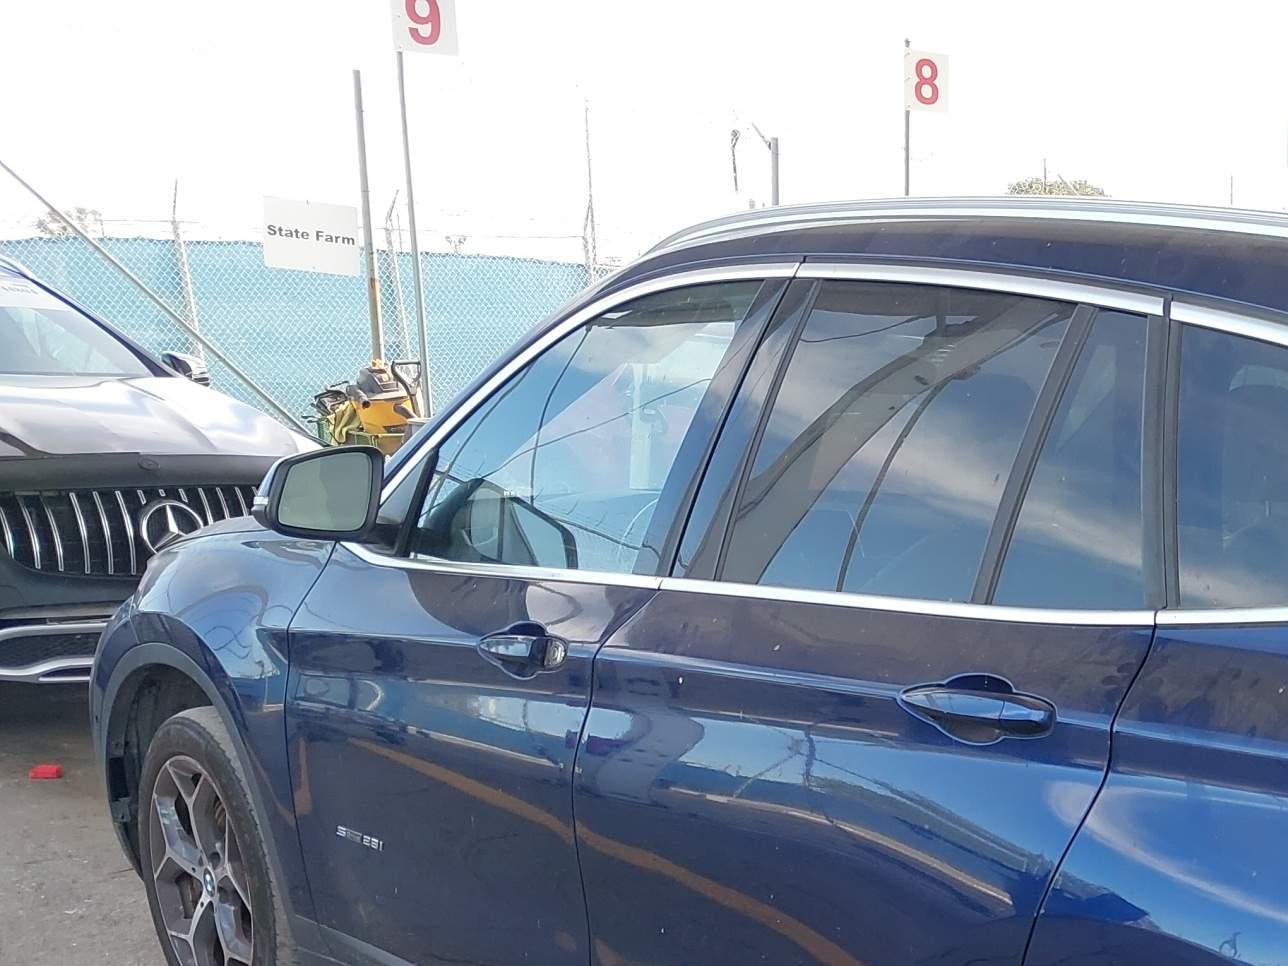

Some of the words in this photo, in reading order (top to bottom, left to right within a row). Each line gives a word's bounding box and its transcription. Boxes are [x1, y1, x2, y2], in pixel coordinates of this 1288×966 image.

[405, 0, 441, 45] 9
[915, 58, 939, 105] 8
[266, 224, 310, 240] State
[315, 230, 355, 246] Farm
